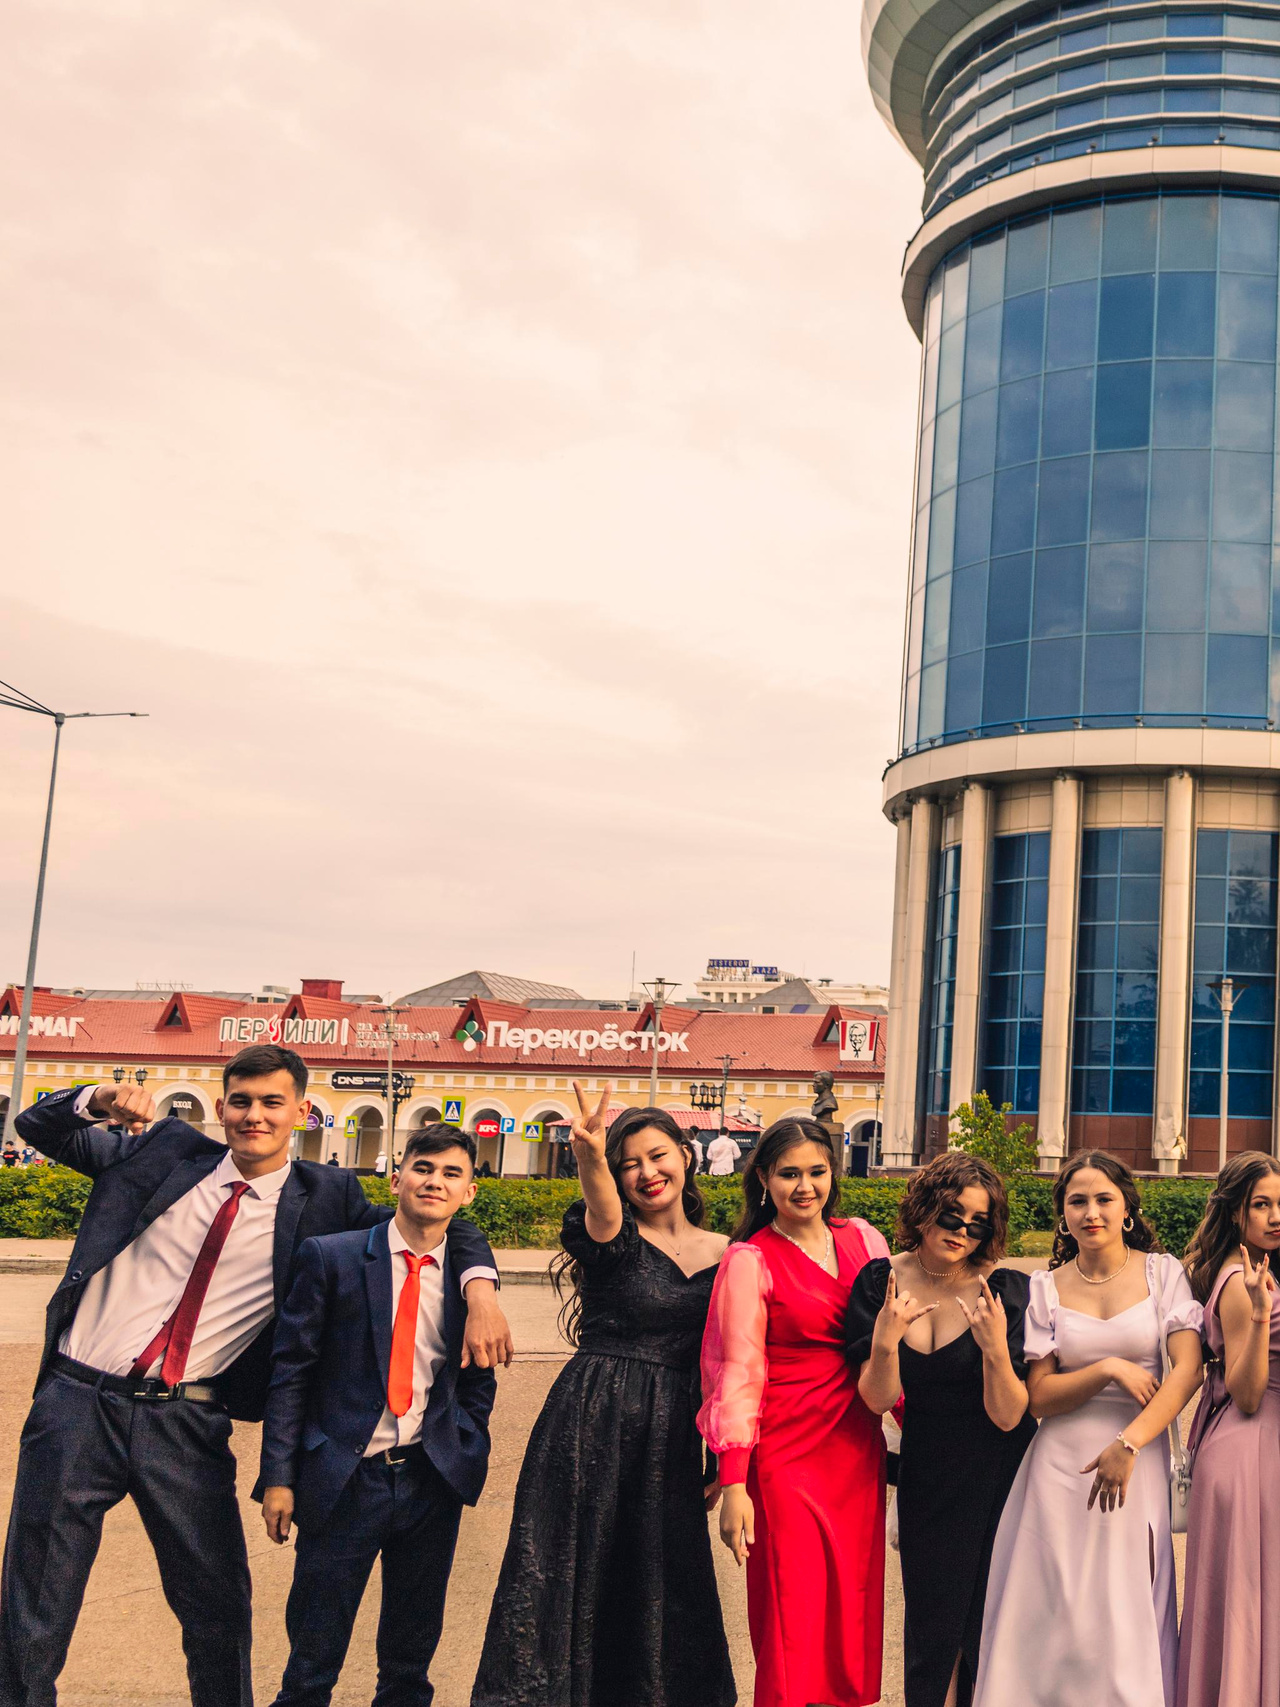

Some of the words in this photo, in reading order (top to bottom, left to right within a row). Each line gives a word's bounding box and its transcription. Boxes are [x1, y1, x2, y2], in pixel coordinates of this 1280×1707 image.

[356, 1023, 372, 1031] НА
[379, 1023, 408, 1032] ОНЕ
[356, 1031, 439, 1041] ИТАЛЯНСКОЙ
[486, 1021, 690, 1056] Перекрёсток
[337, 1076, 364, 1085] DNS
[172, 1101, 192, 1109] ВХОД
[478, 1124, 498, 1132] KFC
[503, 1119, 513, 1131] P
